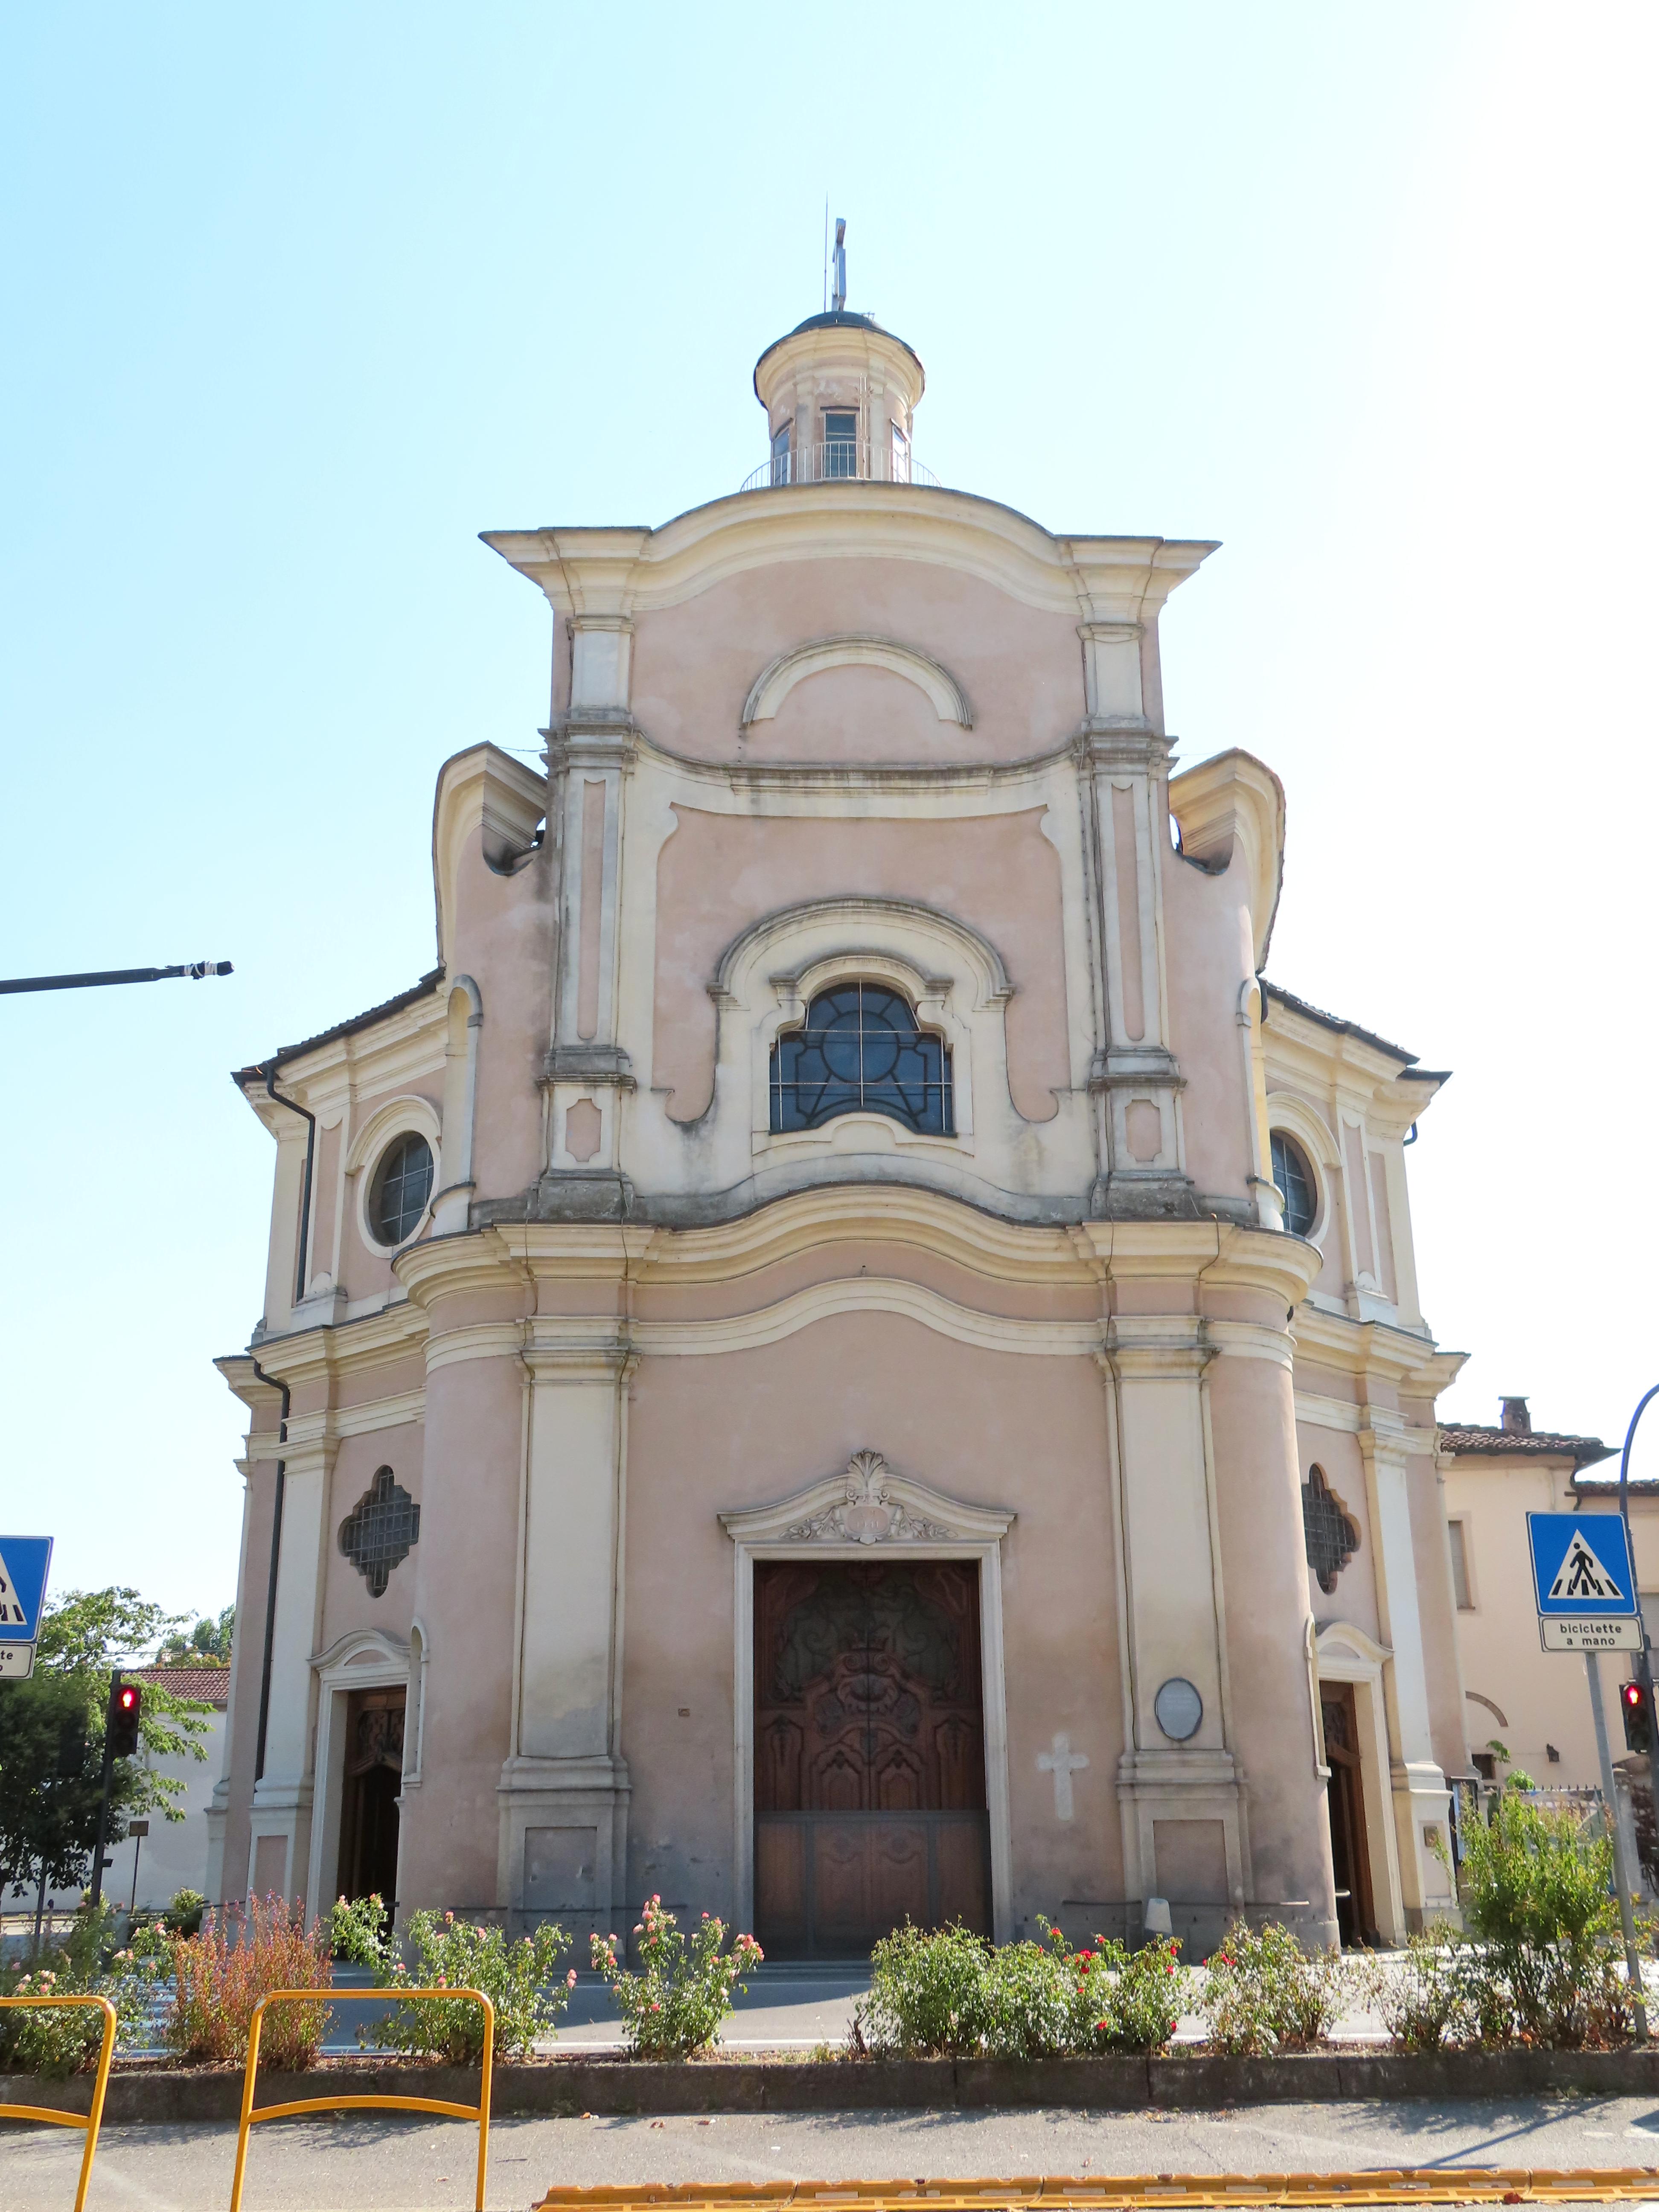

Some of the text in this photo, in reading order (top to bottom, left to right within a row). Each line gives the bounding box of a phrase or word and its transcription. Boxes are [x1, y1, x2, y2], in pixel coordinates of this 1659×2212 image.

[1560, 1623, 1622, 1633] biciclette
[1566, 1637, 1615, 1646] a mano
